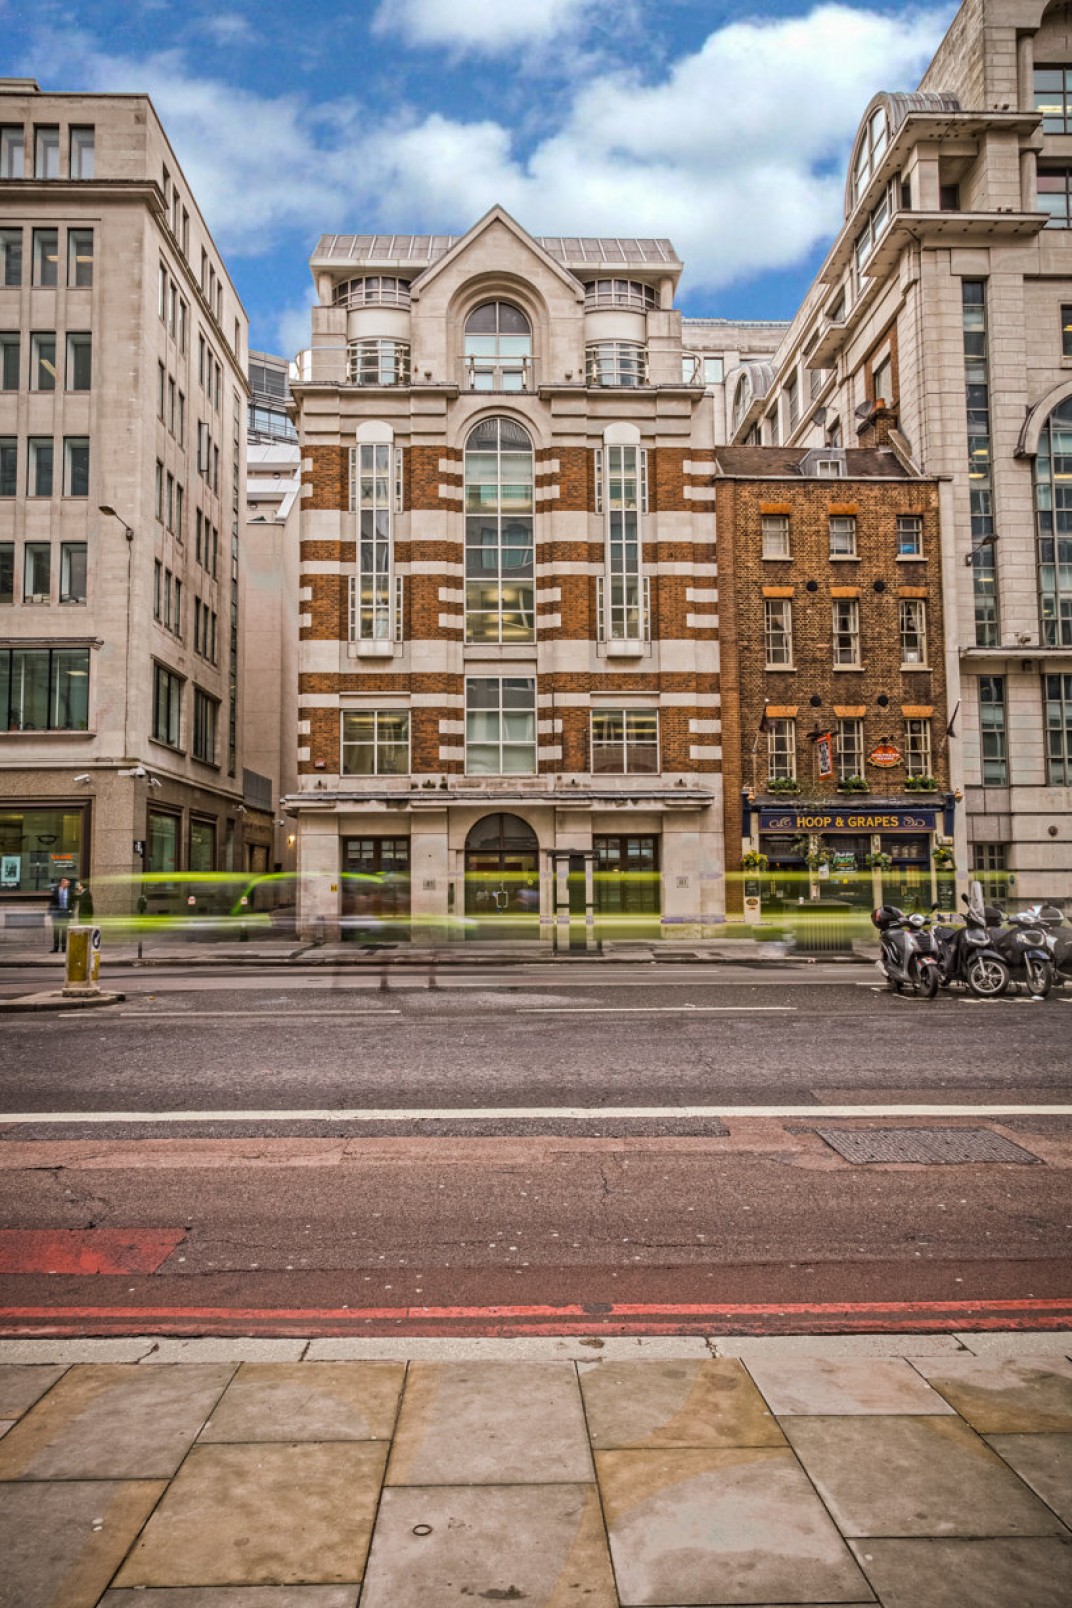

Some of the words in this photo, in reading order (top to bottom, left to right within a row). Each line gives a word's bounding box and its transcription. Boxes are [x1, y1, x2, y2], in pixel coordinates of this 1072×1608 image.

[796, 816, 832, 828] HOOP
[835, 816, 845, 828] &
[847, 816, 900, 828] GRAPES
